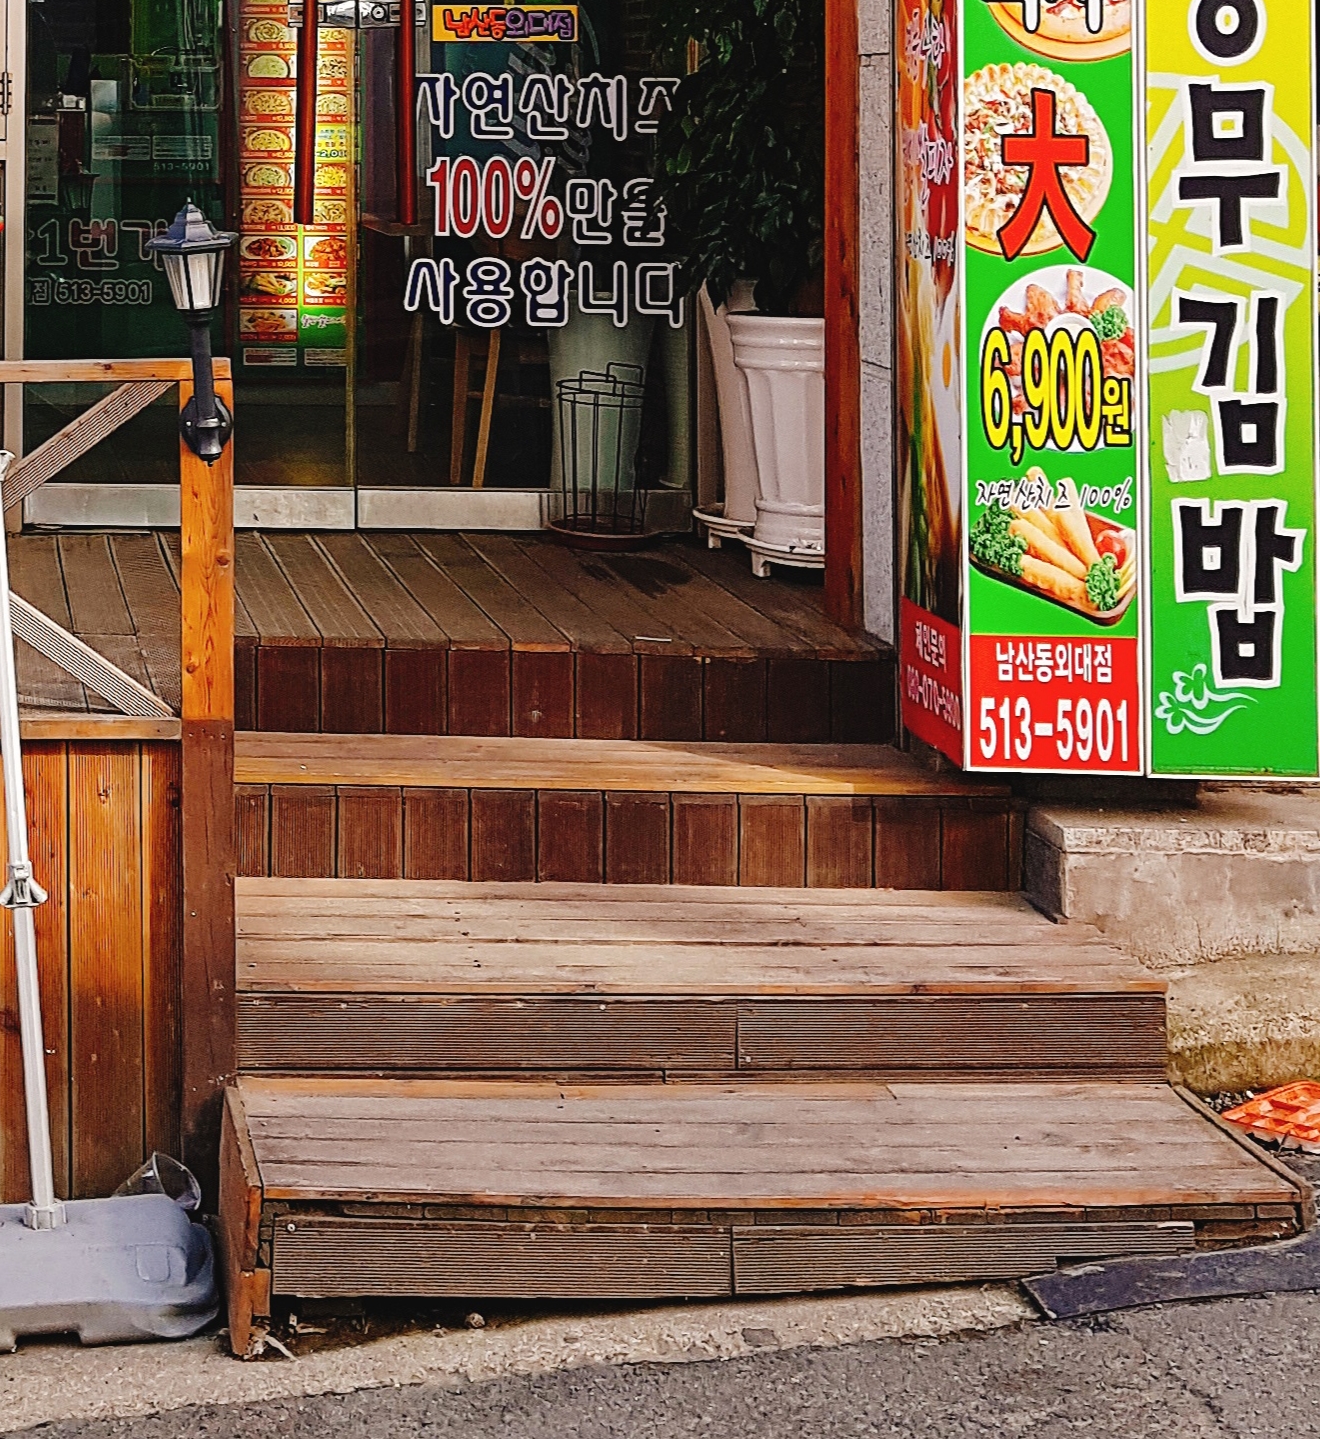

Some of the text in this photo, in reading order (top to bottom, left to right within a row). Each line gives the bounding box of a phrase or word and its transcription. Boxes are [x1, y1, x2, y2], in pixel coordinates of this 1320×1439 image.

[443, 9, 574, 40] 남산동외대점
[997, 87, 1097, 263] 大
[56, 280, 152, 304] 513-5901
[403, 257, 685, 328] 사용합니다
[981, 327, 1133, 465] 6,900원
[1079, 476, 1133, 512] 100%
[994, 642, 1113, 685] 남산동외대점
[980, 696, 1130, 762] 513-5901
